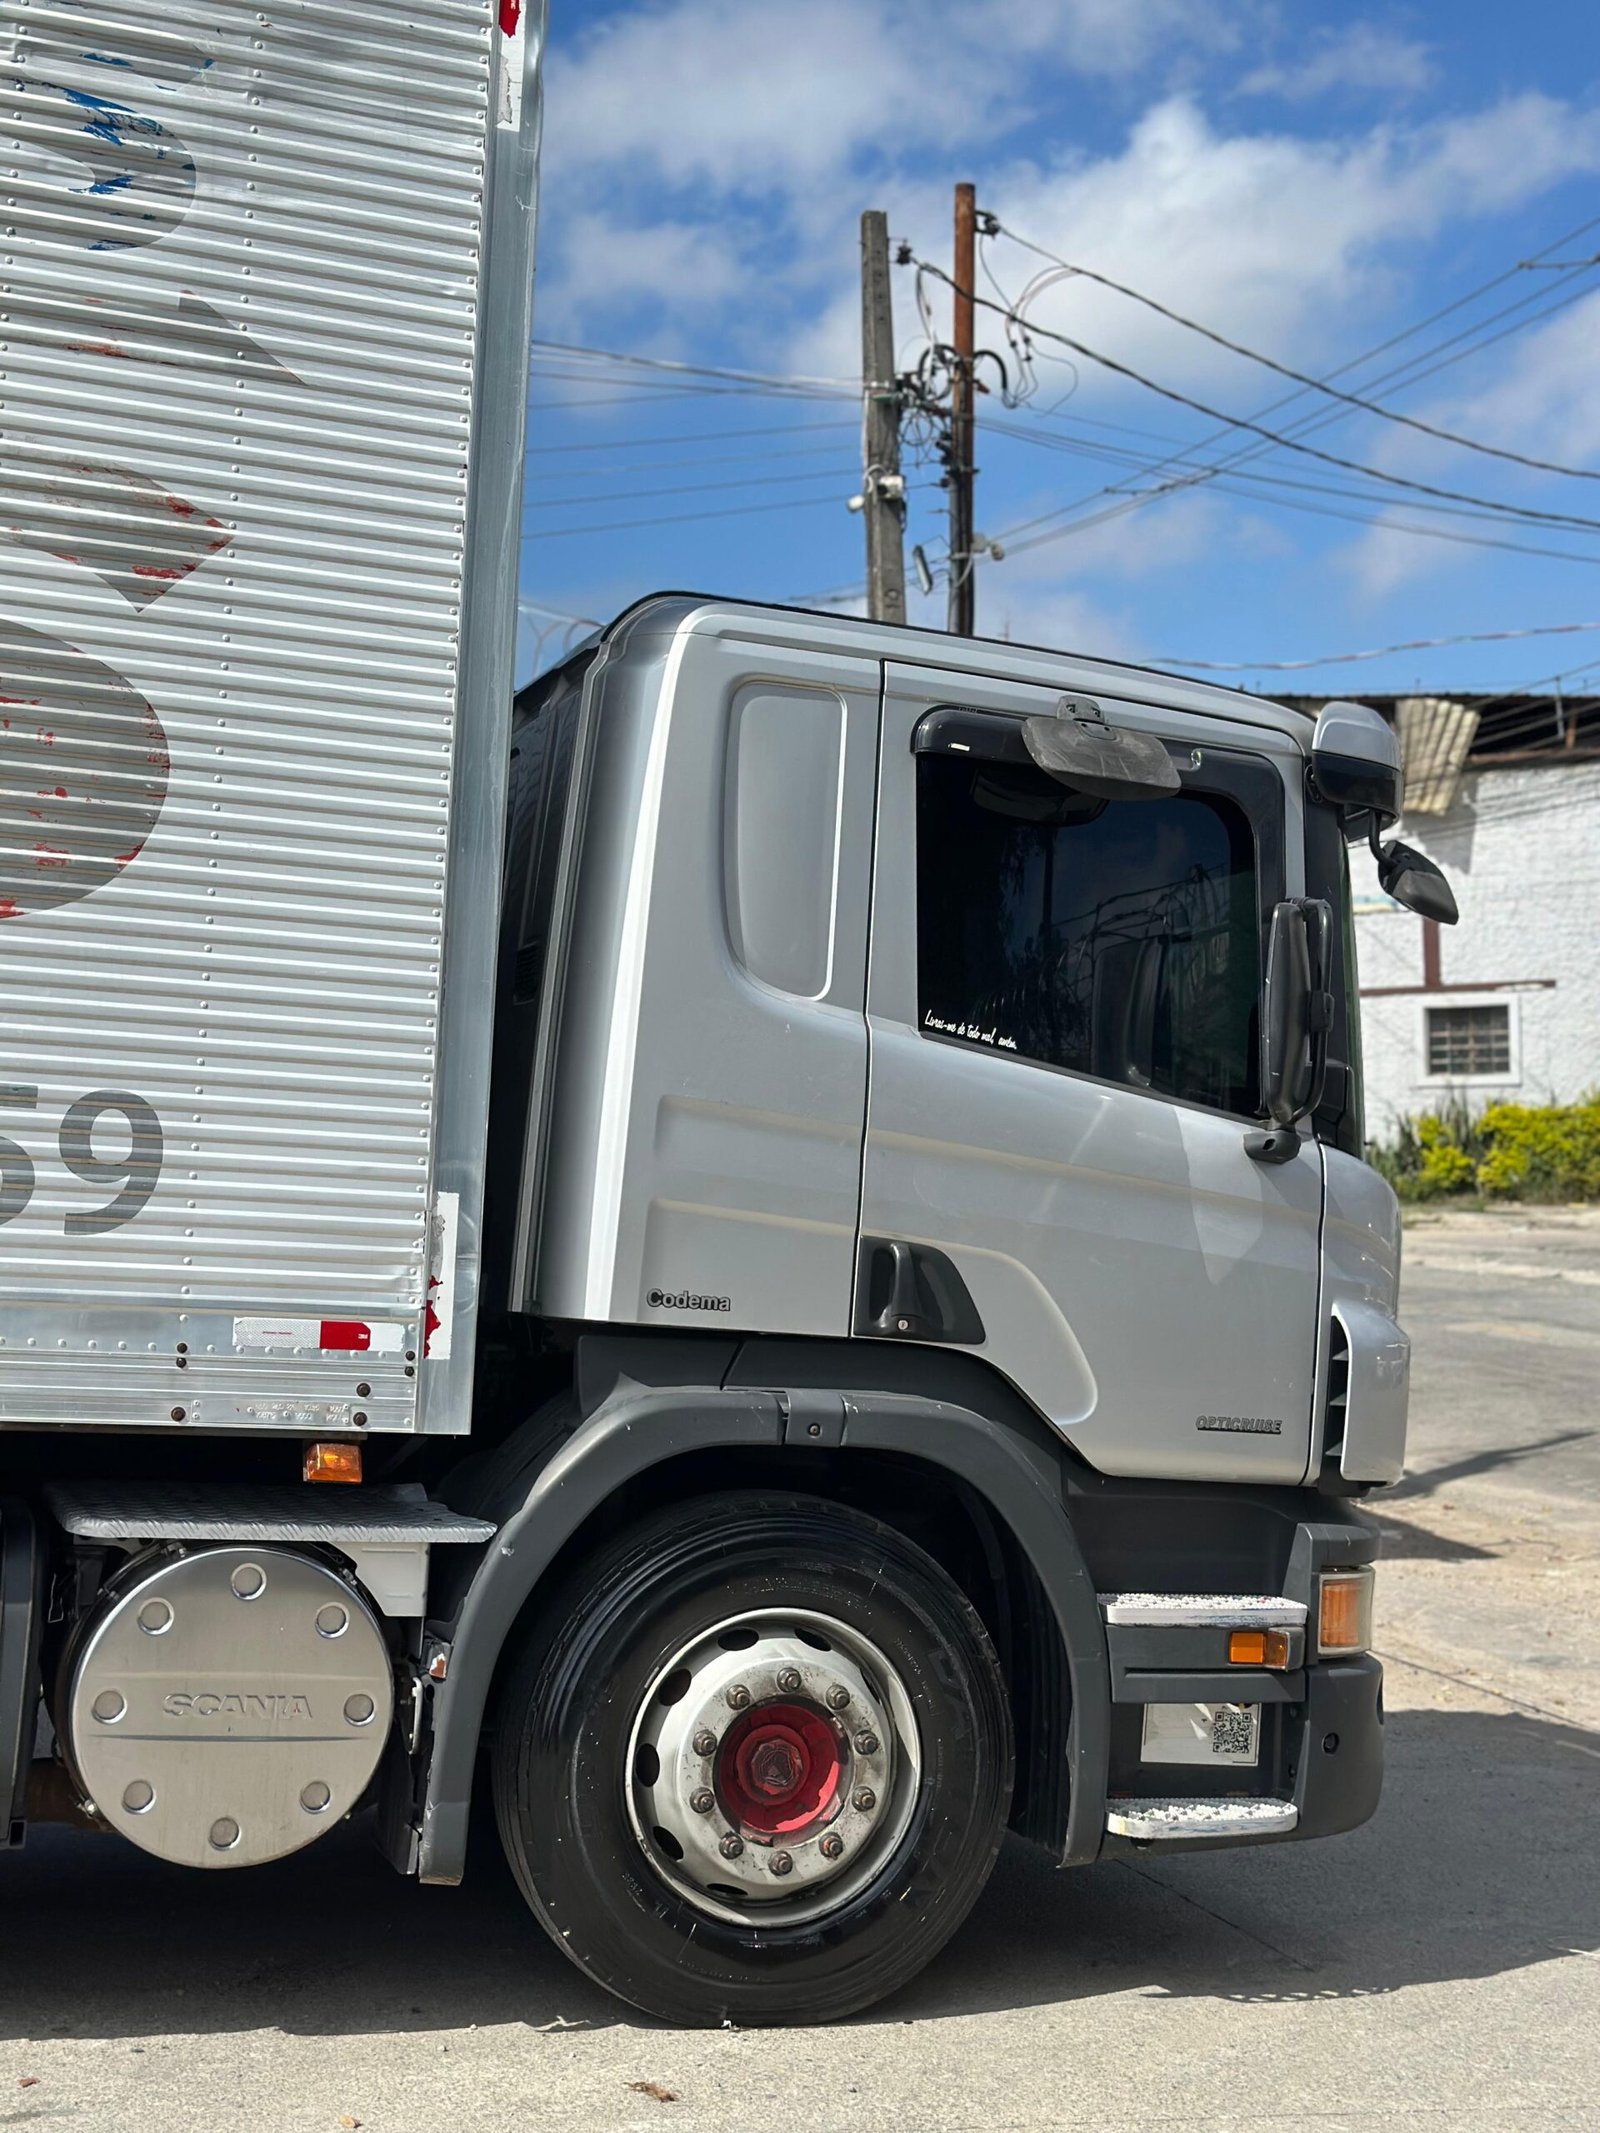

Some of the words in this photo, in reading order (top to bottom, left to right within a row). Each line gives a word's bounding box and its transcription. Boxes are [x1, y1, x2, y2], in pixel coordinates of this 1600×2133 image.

[957, 1022, 966, 1035] de
[646, 1287, 731, 1312] Codema
[1195, 1415, 1283, 1434] OPTICRUISE
[163, 1693, 313, 1720] SCANIA
